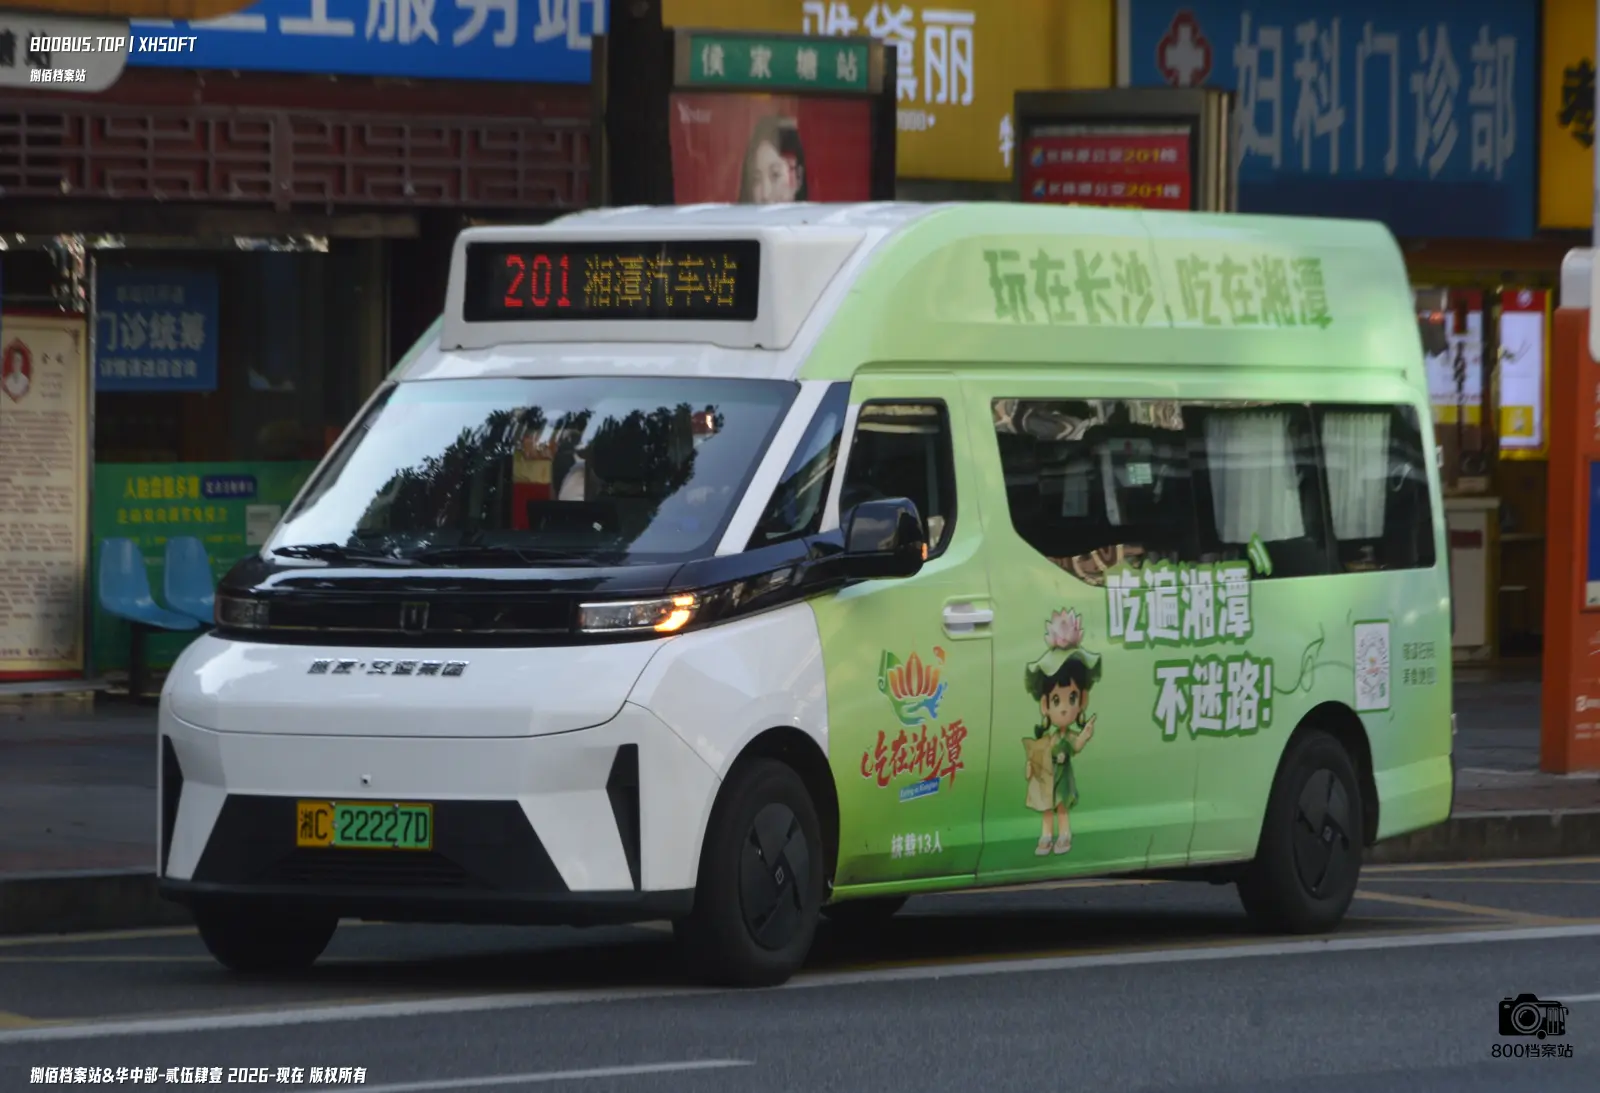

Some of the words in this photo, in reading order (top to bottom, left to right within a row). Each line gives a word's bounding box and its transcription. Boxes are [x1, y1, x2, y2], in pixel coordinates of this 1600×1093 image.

[1233, 11, 1517, 181] 妇科门诊部
[504, 253, 572, 307] 201
[583, 253, 738, 307] 湘潭汽车站
[1106, 566, 1251, 643] 吃遍湘潭
[1155, 657, 1272, 736] 不迷路!
[860, 718, 968, 790] 吃在湘潭
